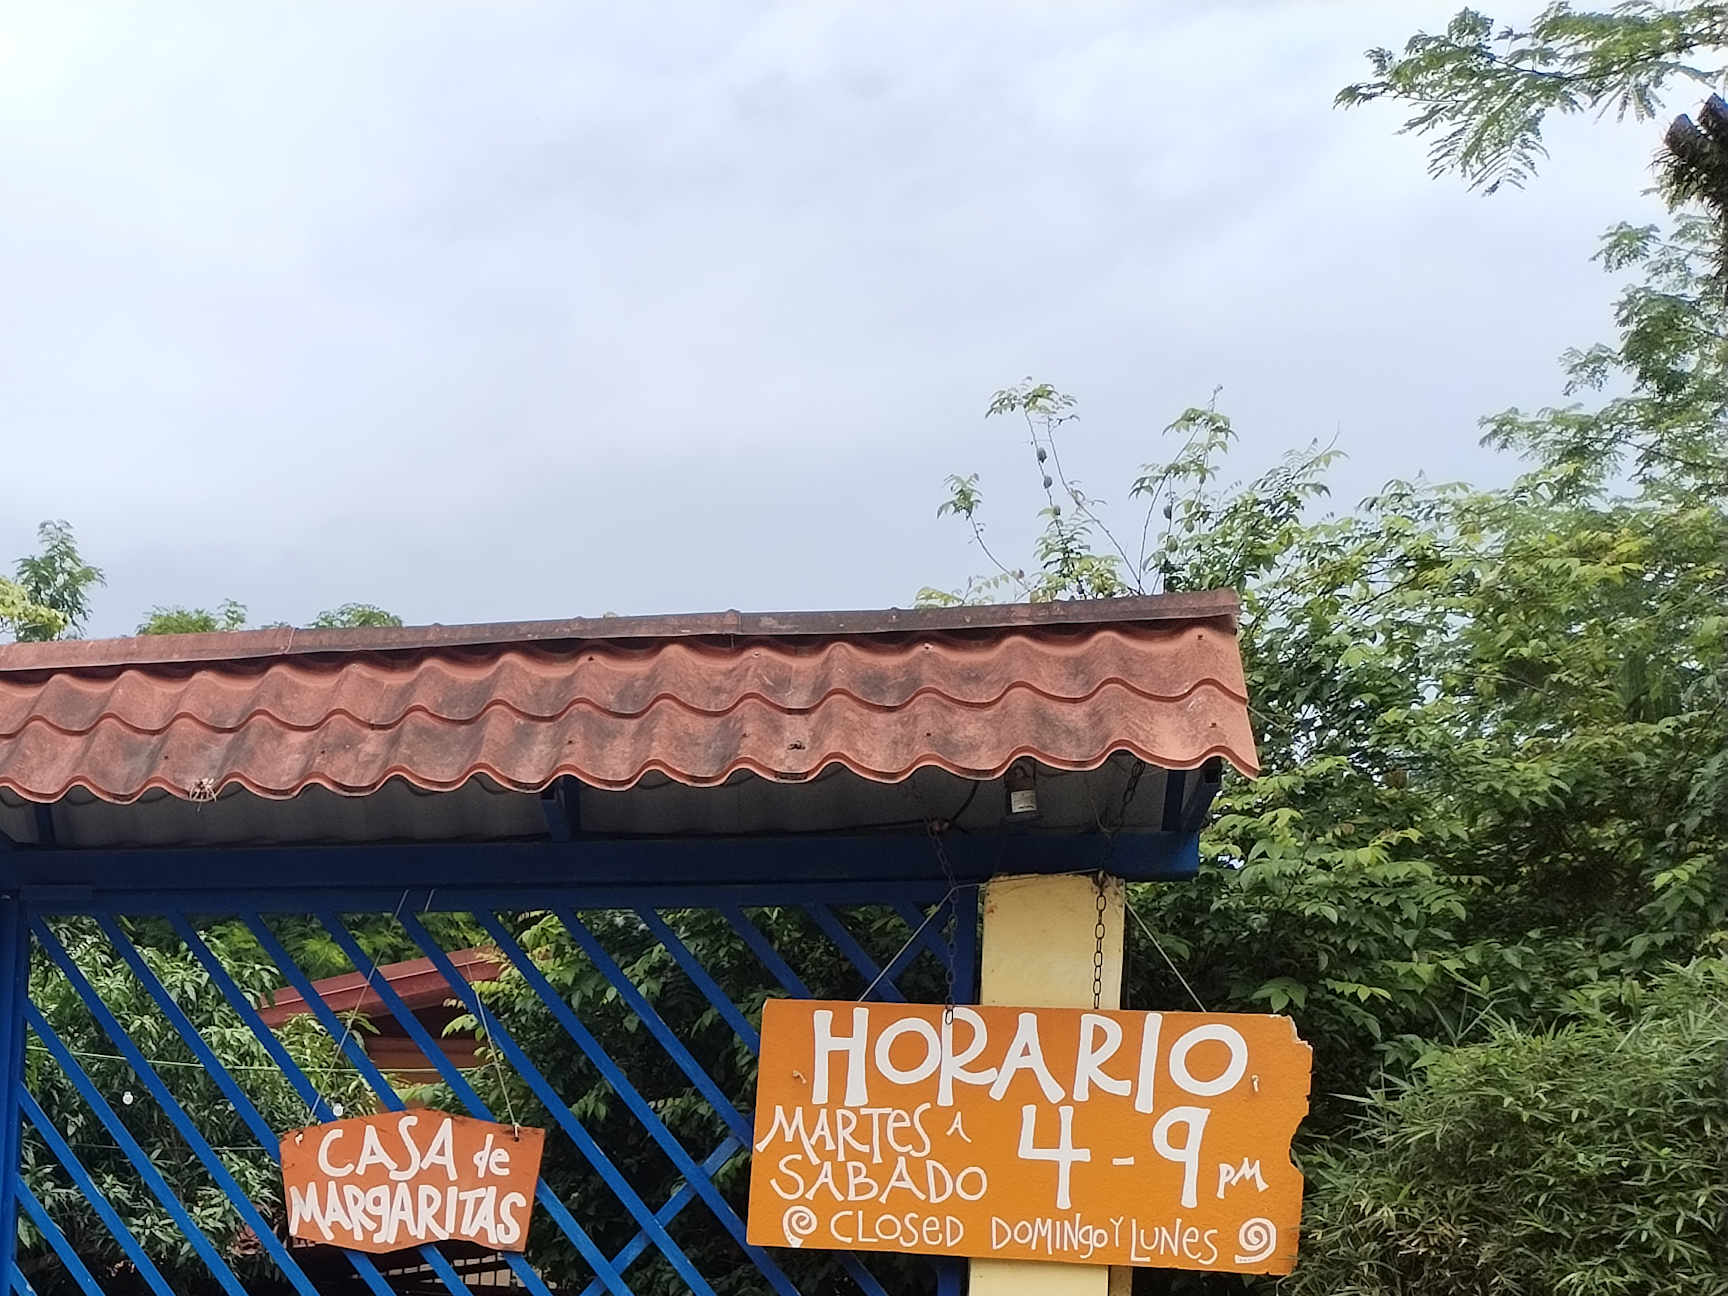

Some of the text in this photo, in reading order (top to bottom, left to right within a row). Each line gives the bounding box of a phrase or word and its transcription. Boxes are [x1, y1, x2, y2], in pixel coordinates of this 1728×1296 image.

[811, 1007, 1249, 1114] HORARIO
[318, 1115, 510, 1181] CASA de
[946, 1111, 972, 1143] A
[769, 1154, 988, 1204] SABADO
